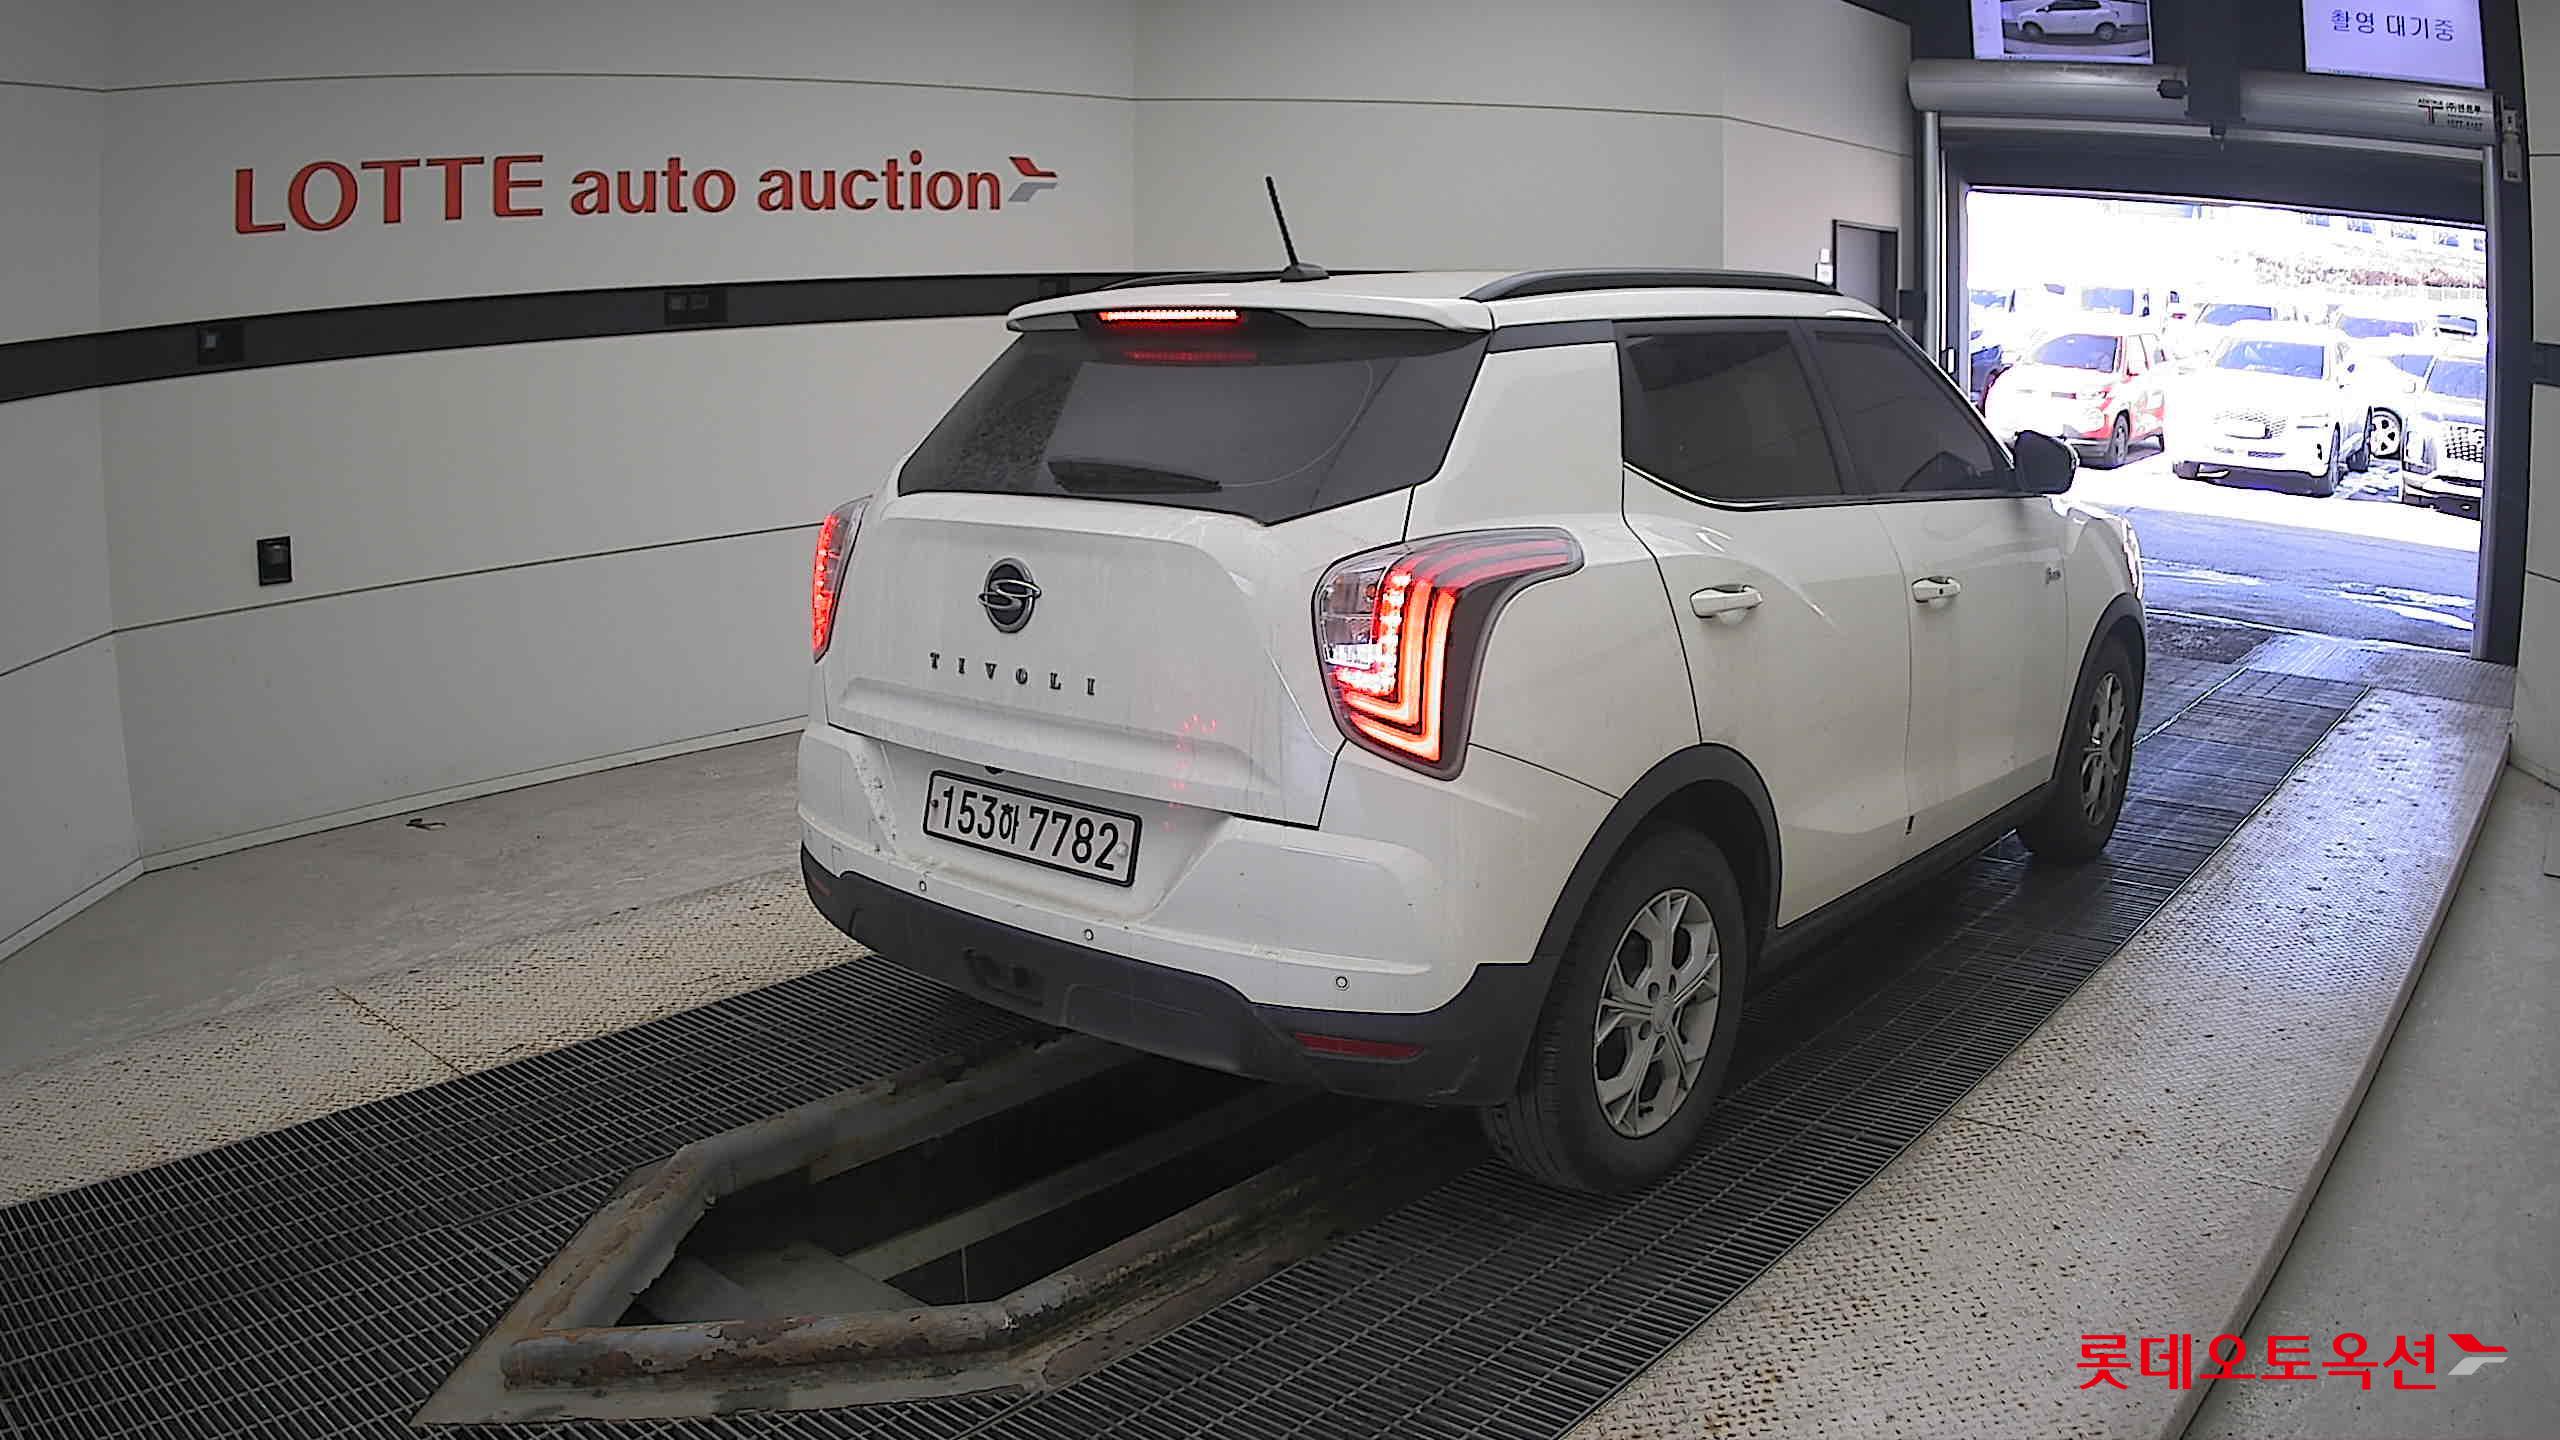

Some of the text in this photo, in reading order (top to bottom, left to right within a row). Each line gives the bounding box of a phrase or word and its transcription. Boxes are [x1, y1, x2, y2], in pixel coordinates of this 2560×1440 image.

[2331, 9, 2453, 42] 촬영 대기중
[235, 150, 1002, 234] LOTTE auto auction
[929, 651, 1096, 696] TIVOLI
